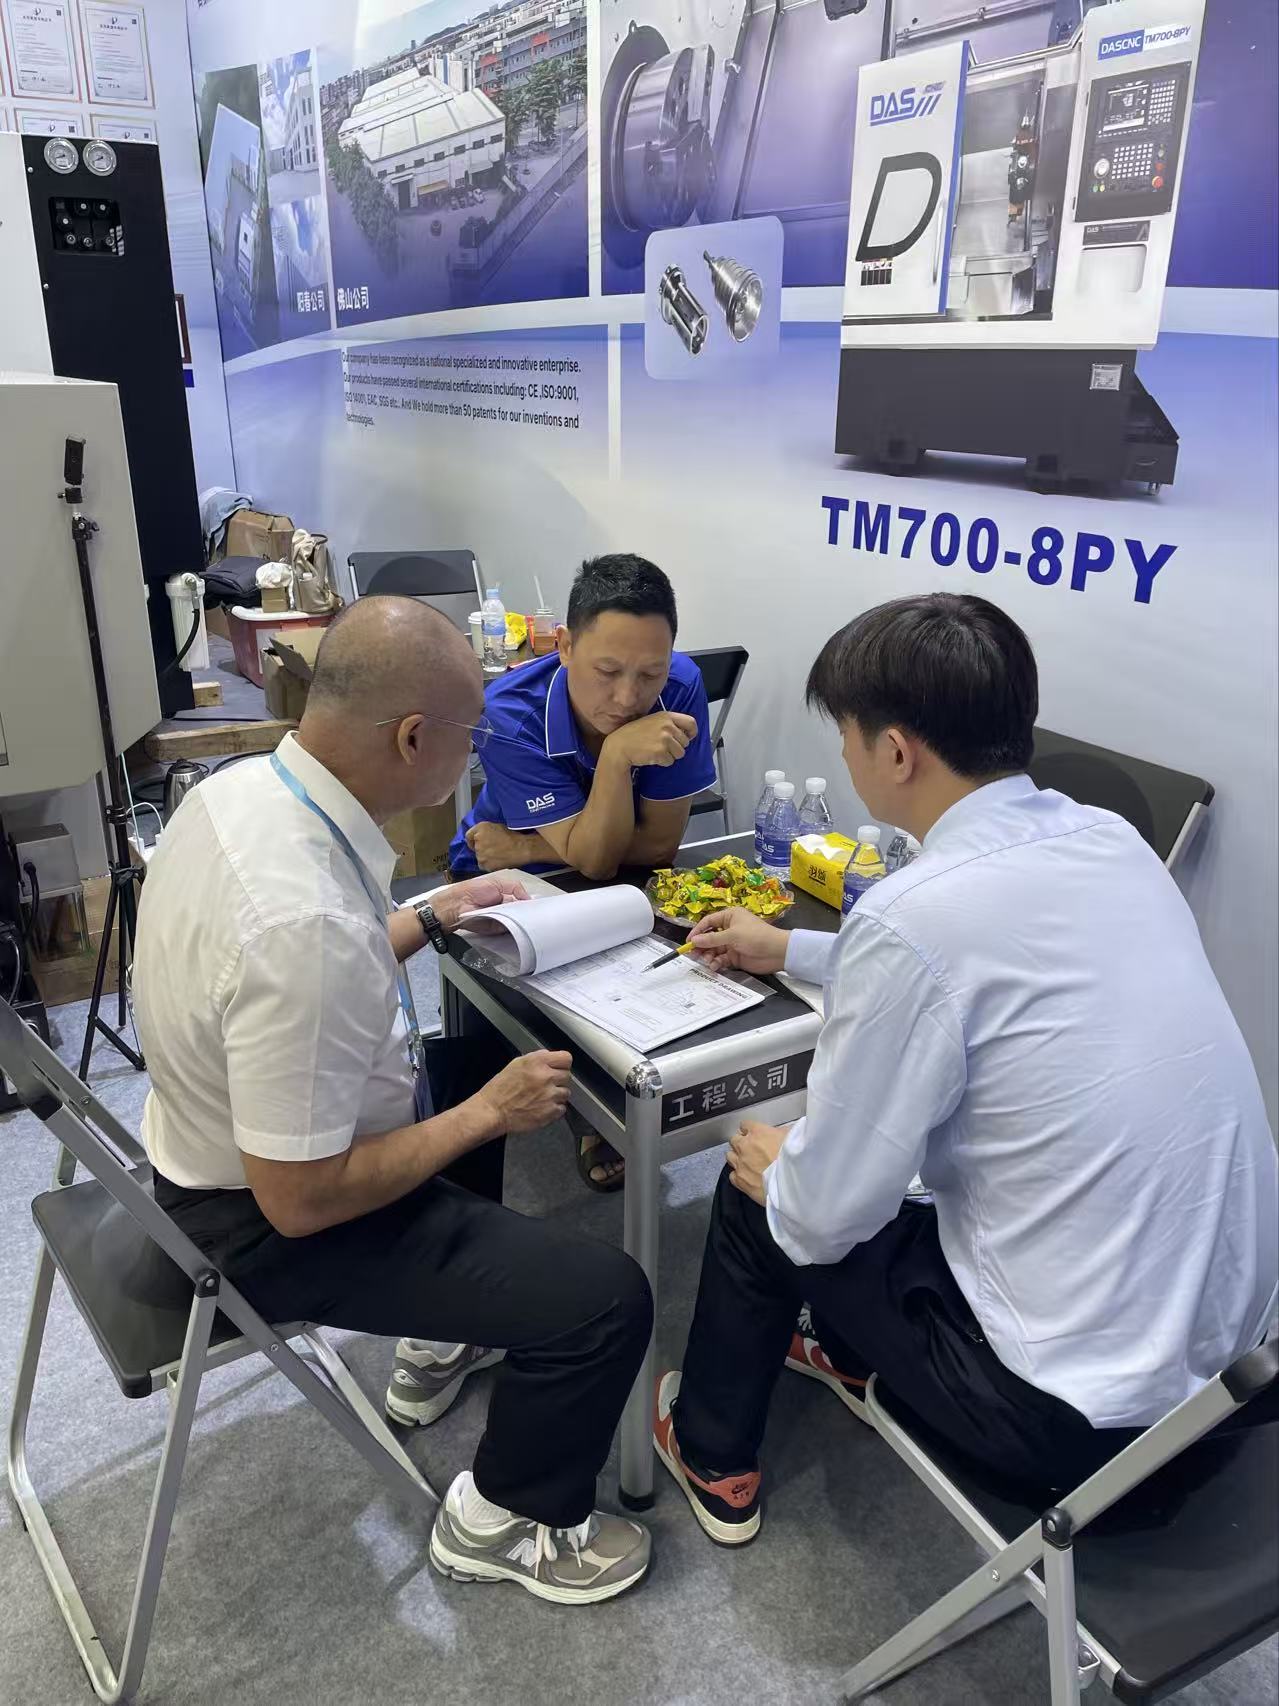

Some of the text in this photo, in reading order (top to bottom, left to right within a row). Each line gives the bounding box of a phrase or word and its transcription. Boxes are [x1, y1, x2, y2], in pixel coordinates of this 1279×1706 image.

[1101, 26, 1192, 54] DASCNC TM700-8PY
[870, 88, 916, 121] DAS
[297, 290, 325, 312] 阳春公司
[337, 286, 369, 310] 佛山公司
[431, 355, 452, 368] national
[453, 356, 487, 371] specialized
[488, 357, 500, 369] and
[501, 356, 538, 371] innovative
[539, 357, 581, 375] enterprise.
[418, 378, 452, 391] international
[453, 380, 493, 395] certifications
[494, 382, 527, 400] including:
[528, 384, 538, 398] CE
[402, 398, 412, 410] And
[413, 399, 421, 411] We
[422, 401, 433, 413] hold
[434, 404, 448, 414] more
[449, 403, 462, 416] than
[463, 404, 472, 417] 50
[473, 406, 497, 420] patents
[498, 407, 508, 421] for
[509, 410, 522, 422] our
[522, 409, 563, 427] inventions
[564, 415, 579, 428] and
[821, 495, 1179, 604] TM700-8PY
[526, 792, 555, 810] DAS
[689, 968, 749, 999] PRODUCT DRAWING
[669, 1064, 788, 1122] 工程公司
